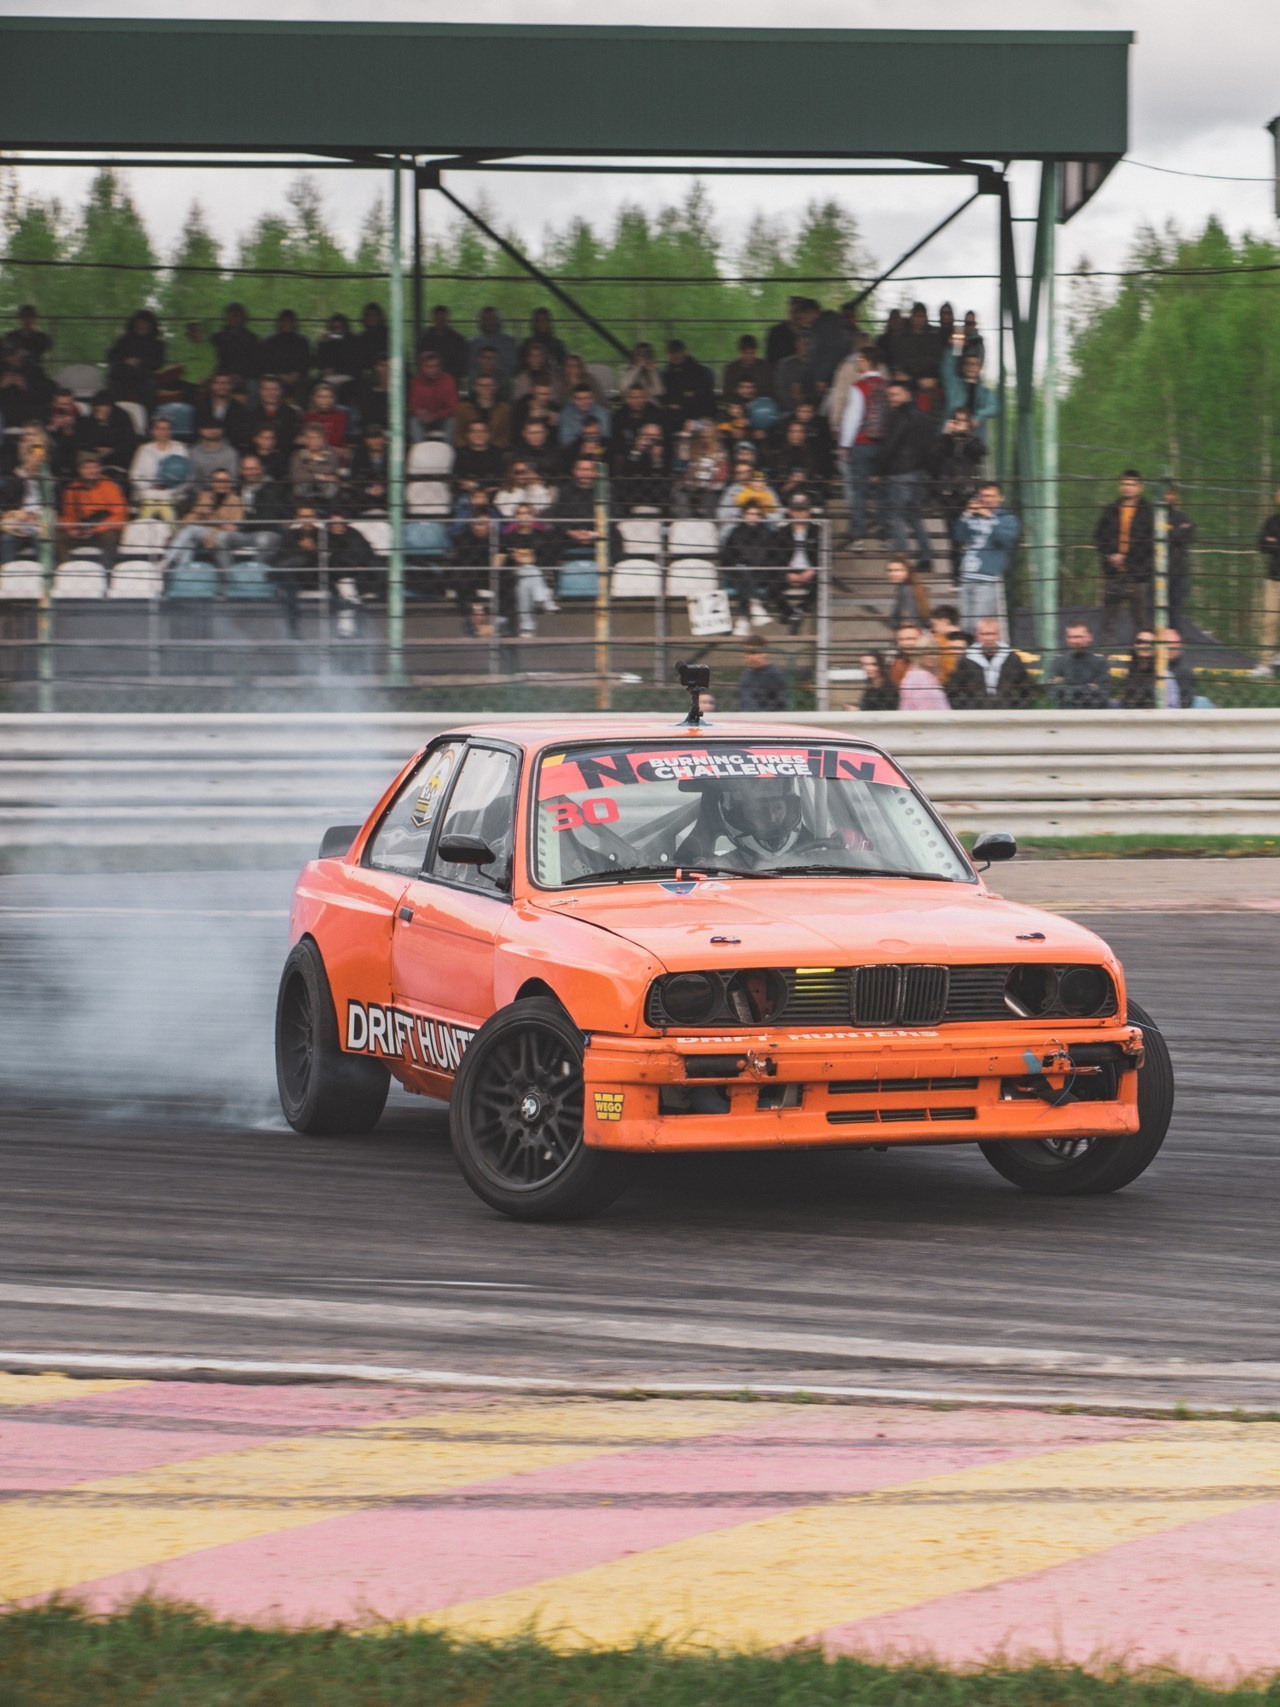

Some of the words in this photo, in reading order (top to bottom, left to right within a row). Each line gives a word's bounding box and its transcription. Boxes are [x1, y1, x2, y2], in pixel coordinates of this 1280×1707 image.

[649, 754, 744, 768] BURNING
[747, 754, 805, 765] TIRES
[655, 763, 812, 779] CHALLENGE
[546, 797, 619, 832] 30
[347, 1001, 418, 1061] DRIFT
[416, 1018, 475, 1071] HUNT
[595, 1101, 622, 1112] WEGO
